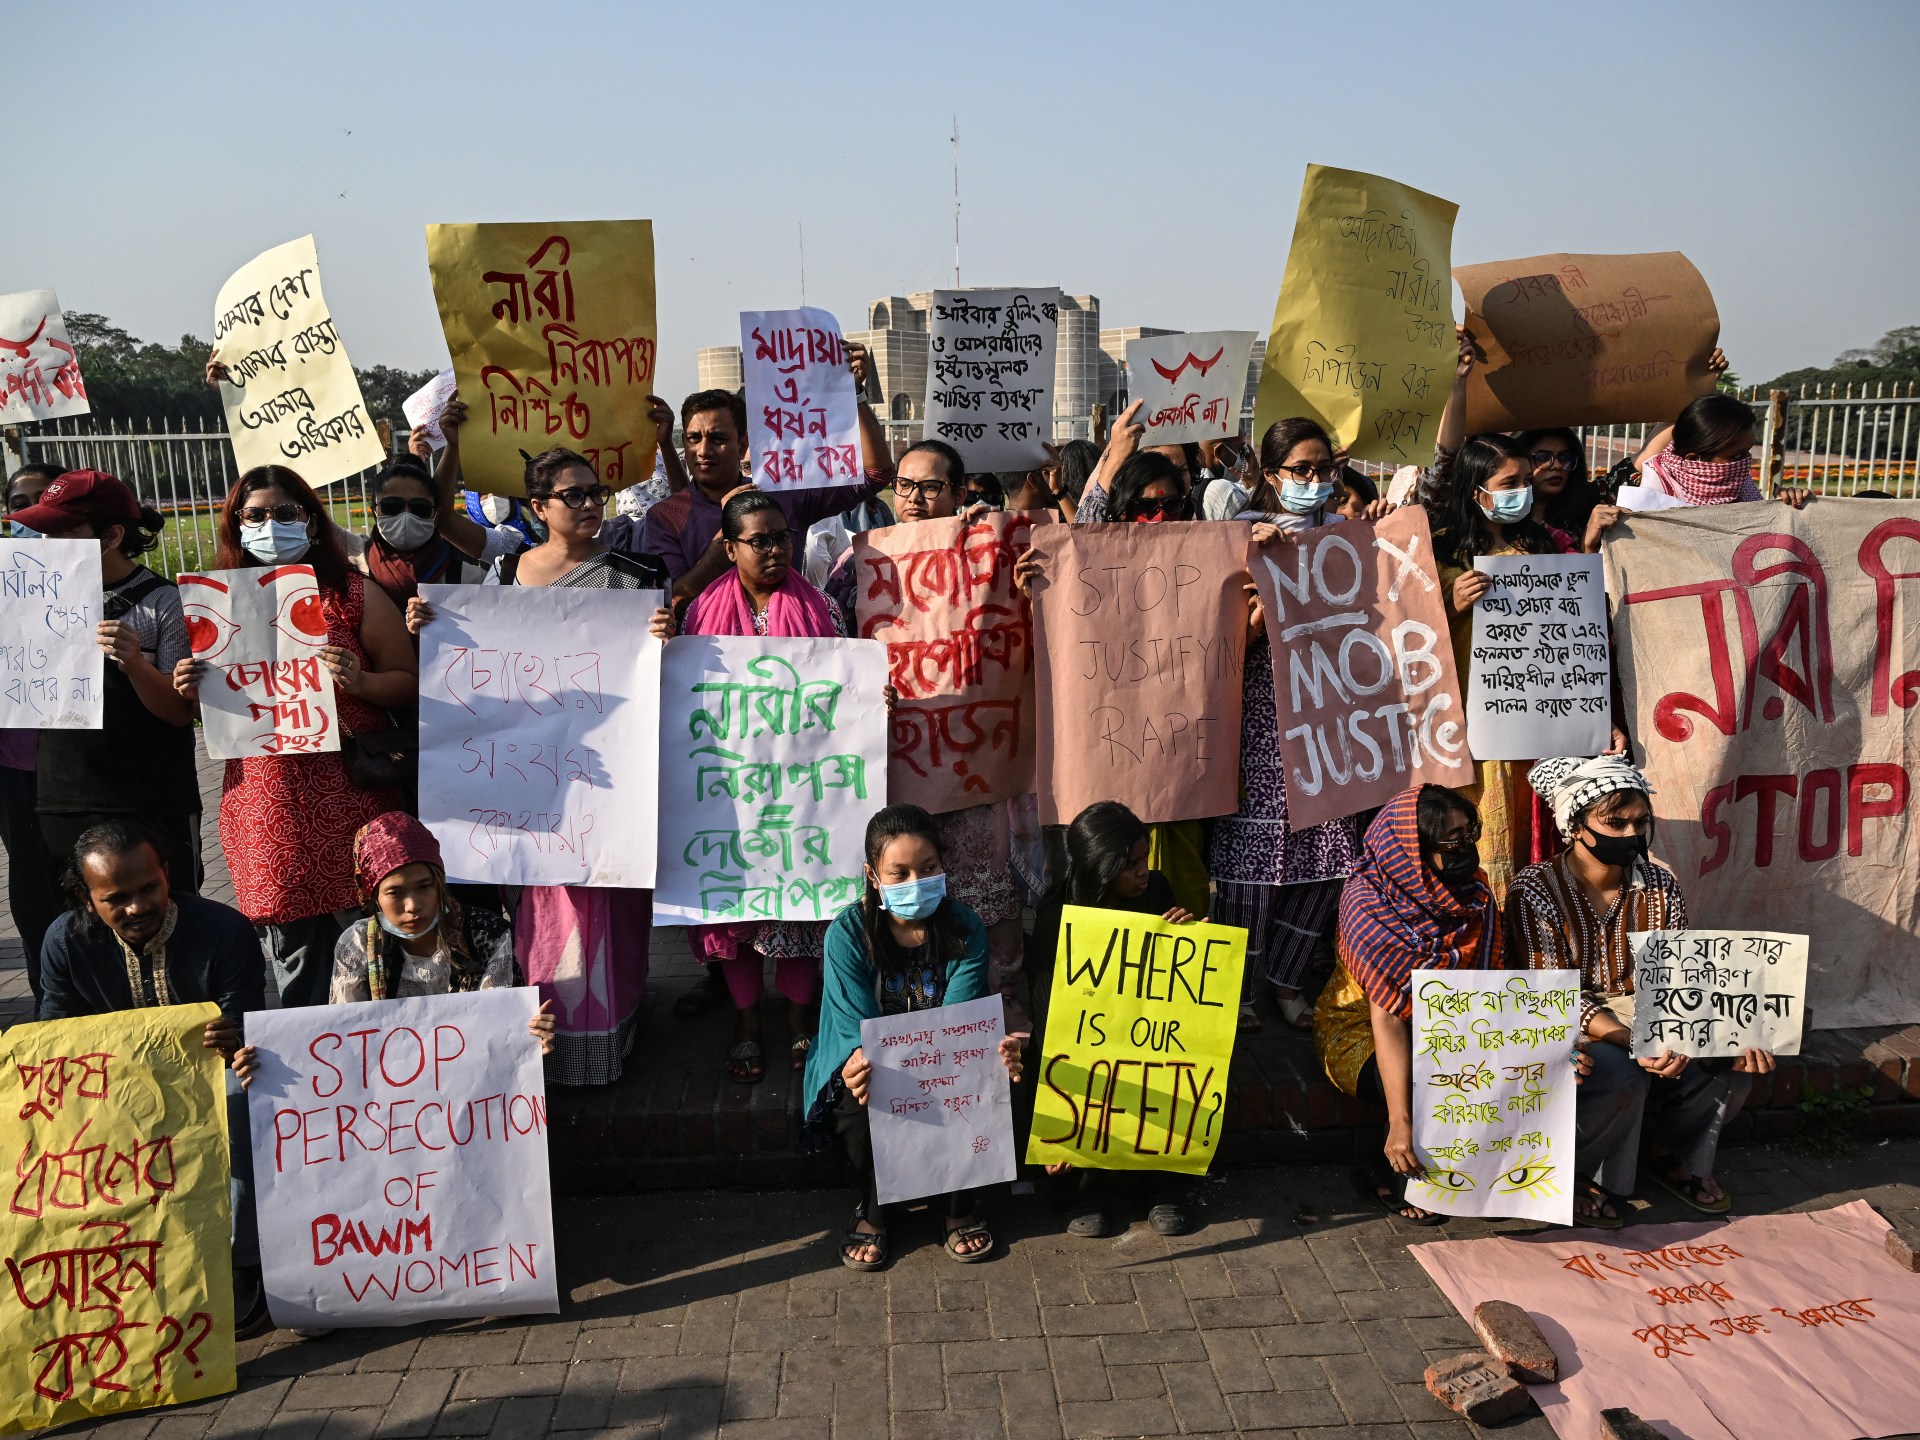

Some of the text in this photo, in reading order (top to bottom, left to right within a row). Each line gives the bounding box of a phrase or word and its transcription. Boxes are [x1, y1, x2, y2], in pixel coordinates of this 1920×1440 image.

[482, 235, 575, 324] নারী
[1386, 258, 1442, 311] নারীর
[215, 268, 312, 341] আমার দেশ
[1003, 294, 1041, 329] বুলিং
[1405, 305, 1445, 349] উপর
[223, 317, 341, 388] আমার রাস্তা
[541, 323, 655, 387] নিরাপত্তা
[932, 328, 1042, 358] ও অপরাধীদের
[773, 377, 799, 404] এ
[933, 354, 1029, 389] দৃষ্টান্তমূলক
[1303, 340, 1436, 399] নিপীড়ন বন্ধ
[239, 387, 316, 429] আমার
[480, 365, 591, 440] নিশ্চিত
[764, 397, 827, 441] ধর্ষন
[932, 385, 1044, 411] শাস্তির ব্যবস্থা
[279, 404, 366, 459] অধিকার
[937, 421, 987, 443] করতে
[1374, 409, 1431, 459] করুন
[762, 443, 858, 485] বন্ধ কর
[0, 551, 63, 600] াবলিক
[1071, 564, 1202, 618] STOP
[1262, 534, 1363, 623] NO
[45, 604, 89, 639] স্পেস
[1482, 596, 1583, 617] তথ্য প্রচার বন্ধ
[1473, 642, 1607, 665] জনমত গঠনে তাদের
[1486, 622, 1607, 643] করতে হবে এবং
[1624, 531, 1836, 742] নারী
[216, 654, 324, 699] চোখের
[444, 647, 603, 716] চোখের
[1289, 619, 1443, 713] MOB
[1481, 663, 1608, 692] দায়িত্বশীল ভূমিকা
[4, 677, 59, 717] বাপের
[245, 693, 312, 730] পর্দা
[688, 655, 843, 741] নারীর
[1485, 698, 1528, 715] পালন
[1535, 698, 1578, 719] করতে
[890, 695, 1021, 794] ছাড়ুন
[1091, 706, 1217, 767] RAPE
[1699, 763, 1911, 879] STOP
[683, 825, 833, 872] দেশের
[1065, 922, 1231, 1007] WHERE
[1646, 932, 1792, 965] ধর্ম যার যার
[1639, 954, 1675, 990] যৌন
[1419, 980, 1479, 1019] বিশ্বের
[1481, 991, 1509, 1015] যা
[1651, 987, 1796, 1029] হতে পারে না
[1076, 1009, 1187, 1053] IS OUR
[1471, 1019, 1504, 1049] চির
[1644, 1018, 1724, 1048] সবার
[309, 1025, 466, 1097] STOP
[1428, 1060, 1546, 1092] অর্ধেক তার
[17, 1052, 116, 1121] পুরুষ
[889, 1098, 934, 1115] নিশ্চিত
[1040, 1054, 1223, 1156] SAFETY?
[1432, 1079, 1548, 1124] করিয়াছে নারী
[274, 1093, 547, 1173] PERSECUTION
[1427, 1138, 1480, 1161] অর্ধেক
[1486, 1137, 1512, 1153] তার
[9, 1119, 179, 1219] ধর্ষণের
[384, 1171, 439, 1211] OF
[311, 1213, 433, 1266] BAWM
[5, 1221, 164, 1312] আইন
[342, 1243, 537, 1302] WOMEN
[1646, 1280, 1735, 1309] সরকার
